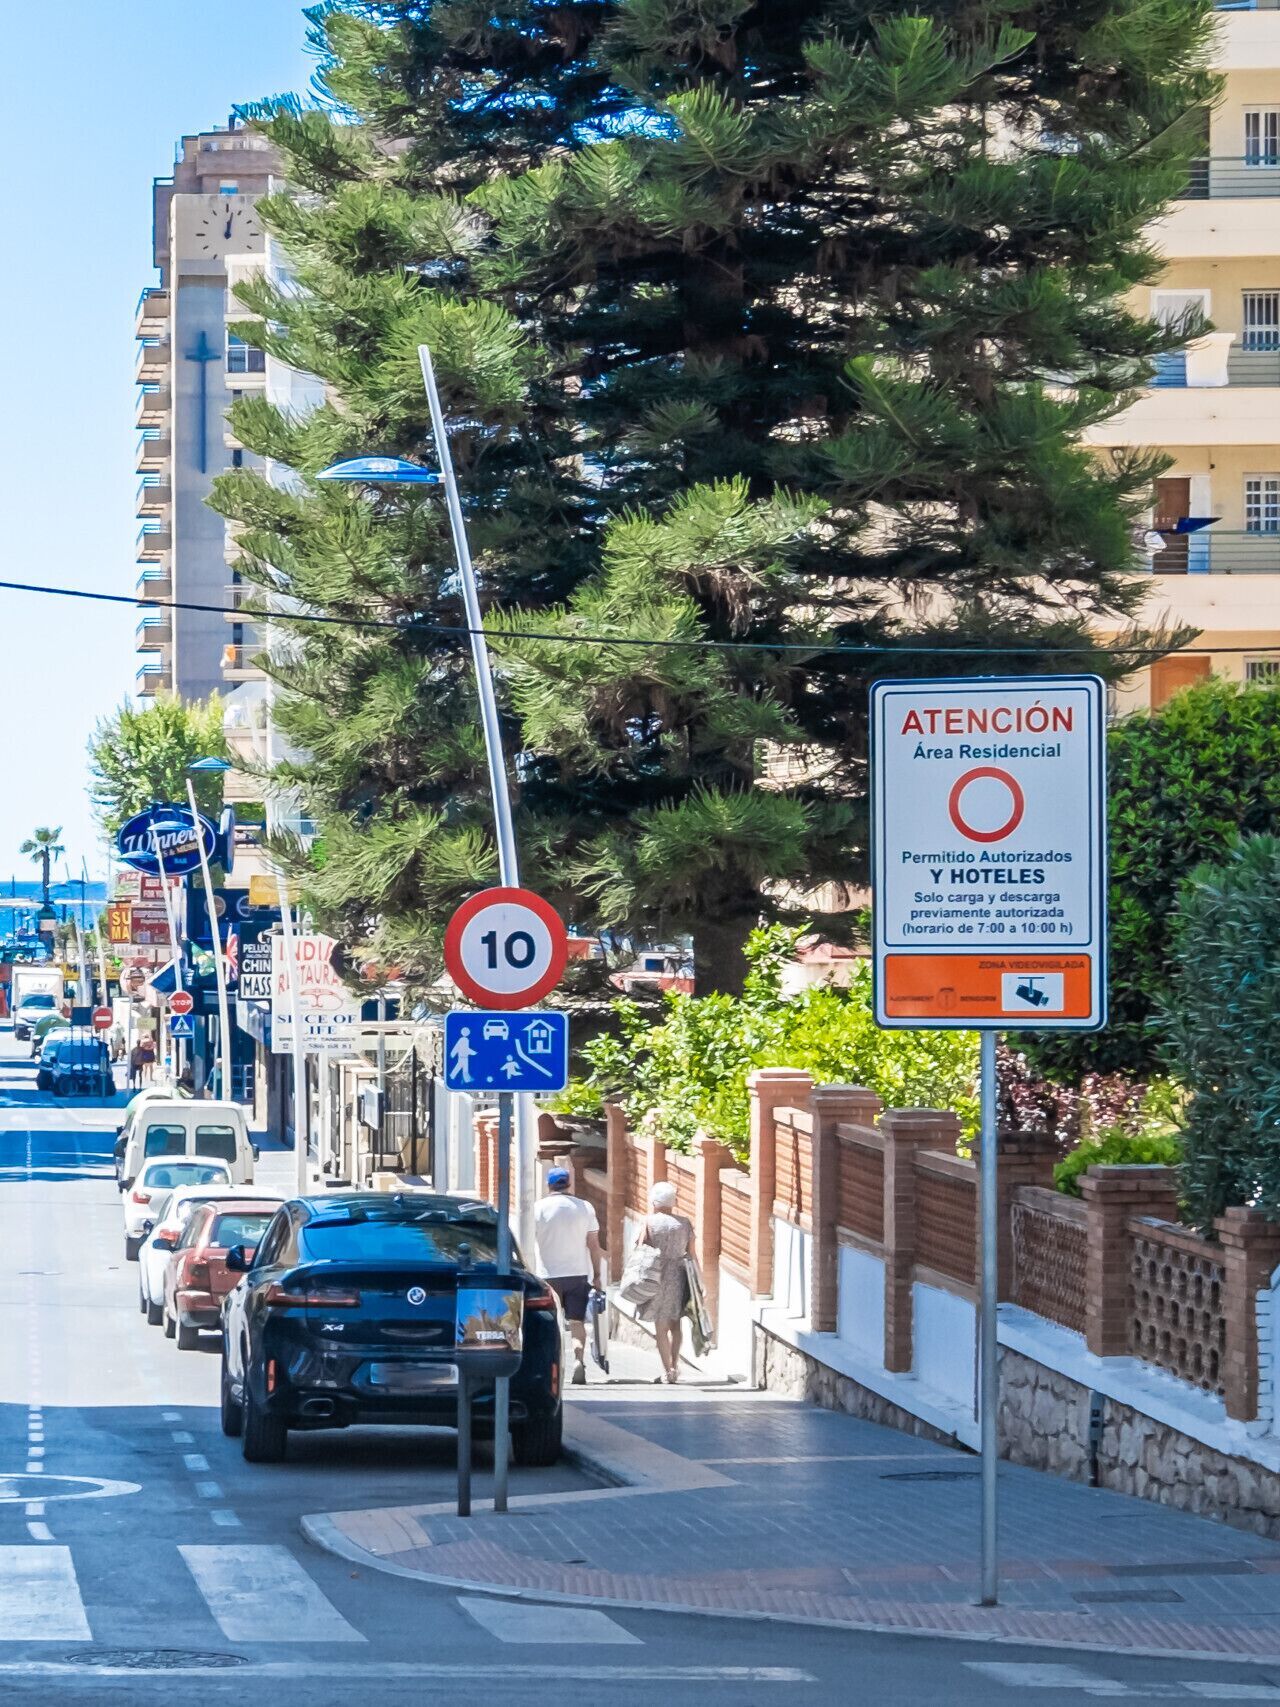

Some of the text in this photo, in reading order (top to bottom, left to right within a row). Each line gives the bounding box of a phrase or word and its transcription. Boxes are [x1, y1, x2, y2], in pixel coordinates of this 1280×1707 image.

[901, 700, 1072, 735] ATENCIÓN
[914, 742, 1061, 760] Área Residencial
[902, 850, 1072, 864] Permitido Autorizados
[930, 868, 1045, 884] Y HOTELES
[914, 892, 1060, 904] Solo carga y descarga
[910, 907, 1064, 920] previamente autorizada
[902, 922, 1073, 936] (horario de 7:00 a 10:00 h)
[480, 930, 536, 970] 10
[1008, 960, 1085, 969] VIDEOVIGILADA
[243, 976, 272, 996] MASS
[278, 1014, 357, 1024] SCE OF
[321, 1324, 344, 1332] X4
